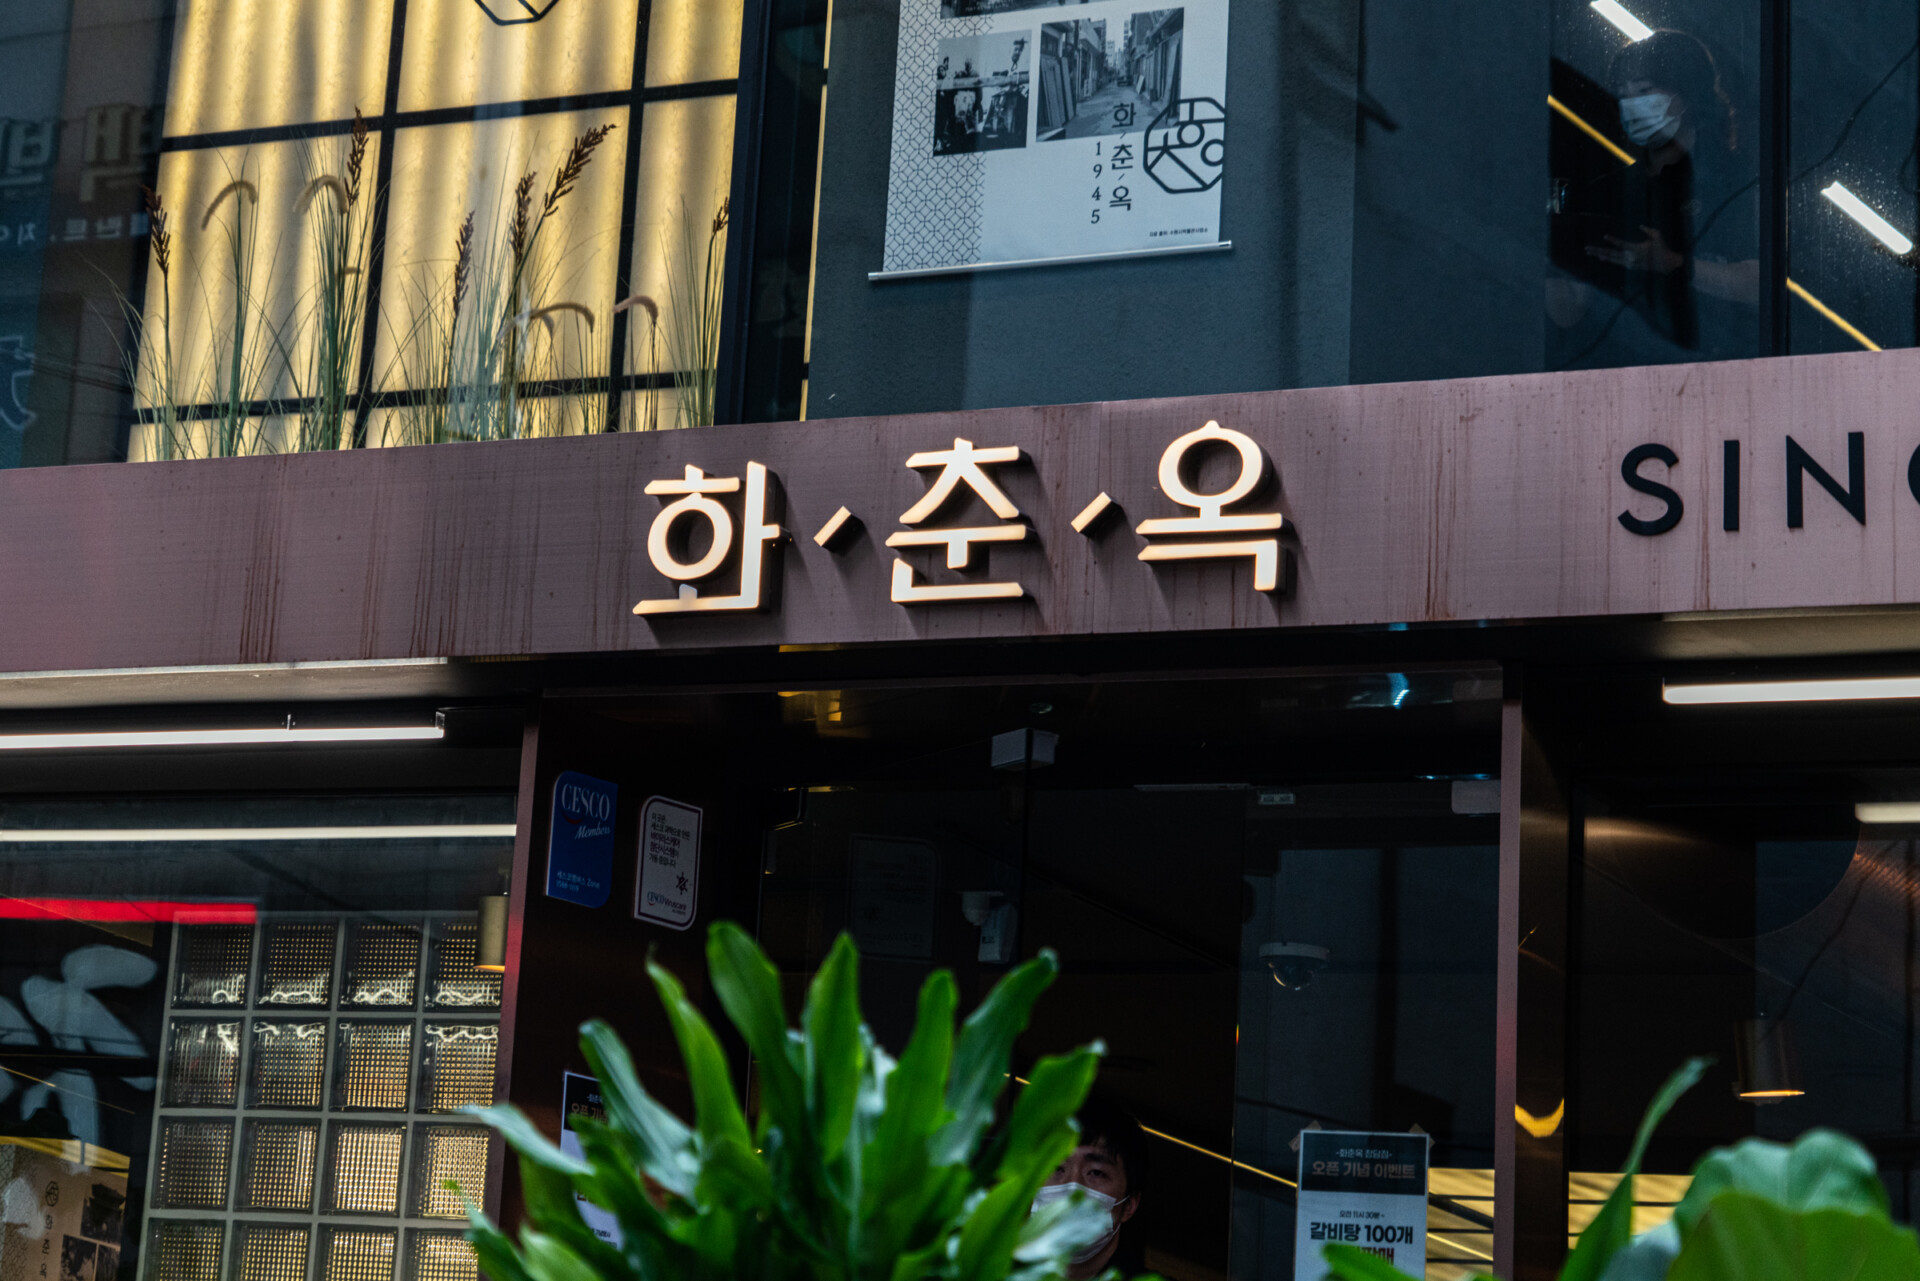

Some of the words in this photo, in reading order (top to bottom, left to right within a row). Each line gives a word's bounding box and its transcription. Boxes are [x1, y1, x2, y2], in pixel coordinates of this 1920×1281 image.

[1090, 141, 1102, 224] 1945
[1617, 431, 1920, 537] SIN
[561, 783, 610, 822] CESCO
[1312, 1161, 1339, 1177] 오픈
[1343, 1162, 1370, 1178] 기념
[1374, 1164, 1416, 1179] 이벤트
[1353, 1211, 1365, 1219] 11시
[1310, 1222, 1361, 1242] 갈비탕
[1364, 1225, 1413, 1245] 100개
